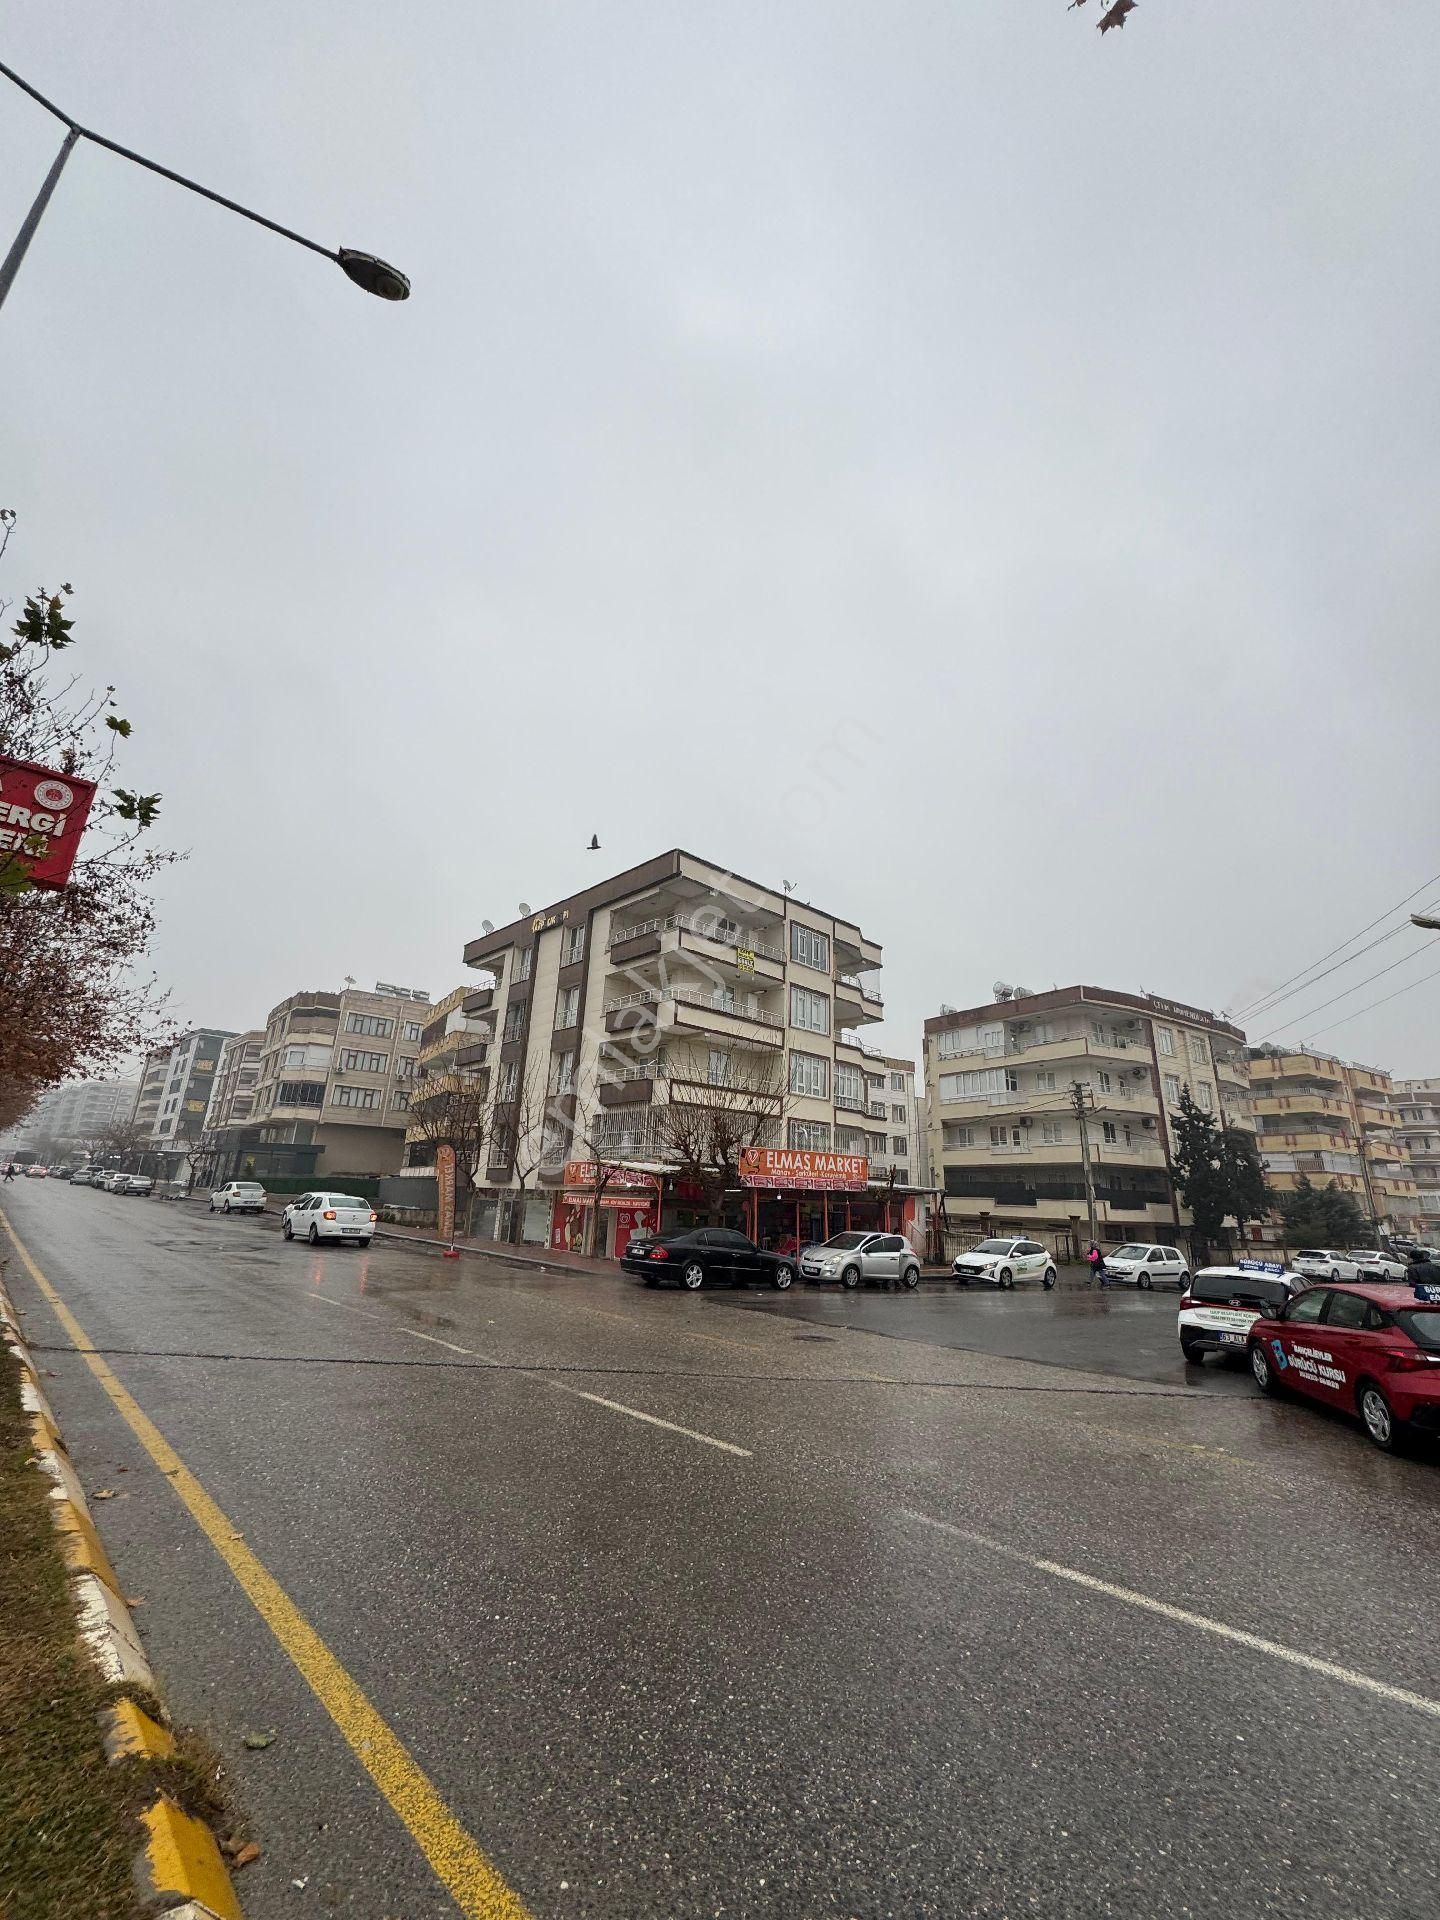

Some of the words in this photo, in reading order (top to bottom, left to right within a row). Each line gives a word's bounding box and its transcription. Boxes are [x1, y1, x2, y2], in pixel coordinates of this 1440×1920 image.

[766, 1150, 811, 1171] ELMAS
[814, 1155, 864, 1174] MARKET
[1317, 1363, 1346, 1383] KURSU
